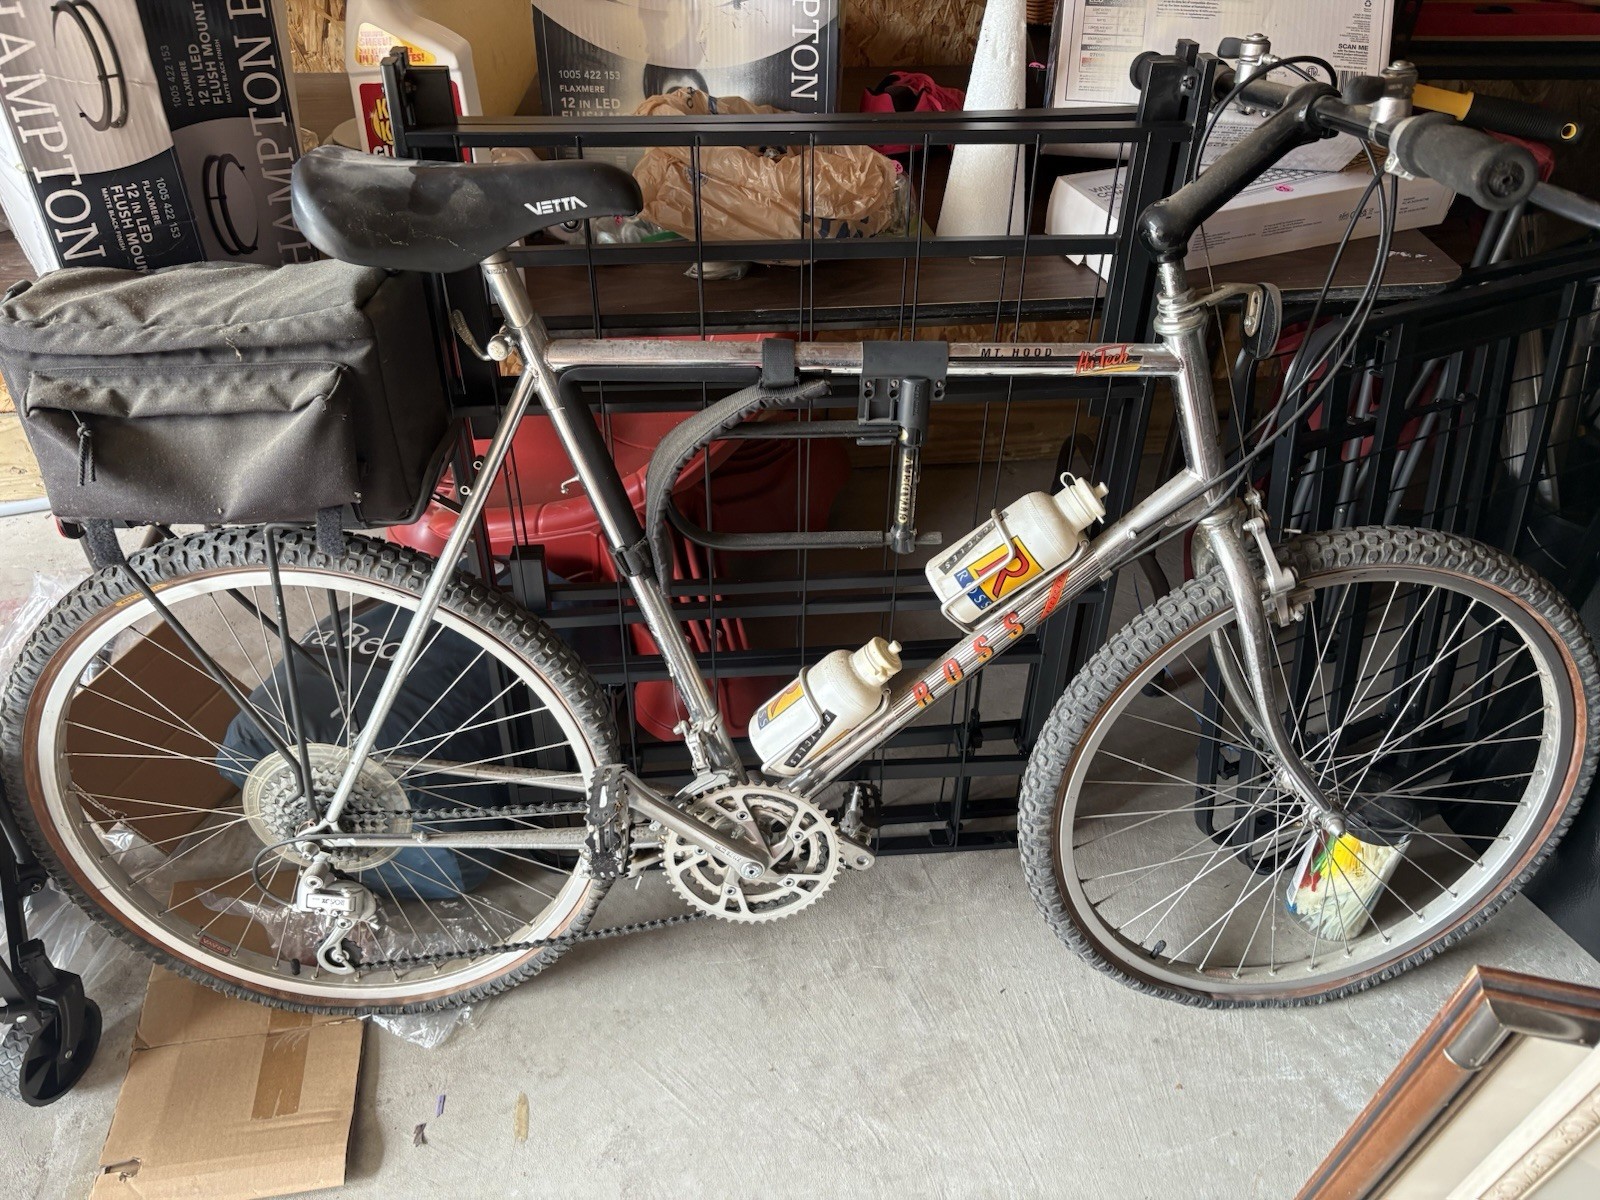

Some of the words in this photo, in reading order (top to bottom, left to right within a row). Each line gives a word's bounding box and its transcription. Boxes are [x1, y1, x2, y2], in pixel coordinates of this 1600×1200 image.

[191, 0, 213, 57] MOUNT
[160, 45, 172, 62] 153
[188, 43, 203, 71] LED
[214, 39, 223, 60] FINISH
[1338, 43, 1357, 51] SCAN
[164, 64, 175, 83] 422
[197, 75, 206, 87] IN
[218, 61, 228, 82] BLACK
[558, 69, 581, 79] 1005
[583, 70, 601, 80] 422
[604, 70, 620, 80] 153
[179, 60, 195, 107] FLAXMERE
[204, 61, 224, 105] FLUSH
[223, 83, 232, 103] MATTE
[560, 84, 605, 93] FLAXMERE
[169, 84, 181, 107] 1005
[198, 90, 210, 106] 12
[561, 97, 576, 109] 12
[579, 99, 591, 109] IN
[595, 98, 620, 109] LED
[0, 1, 106, 261] AMPTON
[126, 183, 140, 199] 12
[156, 177, 170, 201] 1005
[130, 201, 142, 214] IN
[142, 180, 162, 226] FLAXMERE
[164, 202, 176, 220] 422
[523, 195, 588, 216] VETTA
[101, 187, 113, 209] MATTE
[108, 209, 120, 230] BLACK
[115, 230, 127, 251] FINISH
[110, 185, 135, 229] FLUSH
[125, 232, 149, 273] MOUN
[136, 217, 153, 243] LED
[169, 221, 181, 239] 153
[980, 347, 1004, 358] MT.
[1012, 347, 1054, 358] HOOD
[911, 610, 1026, 709] ROSS
